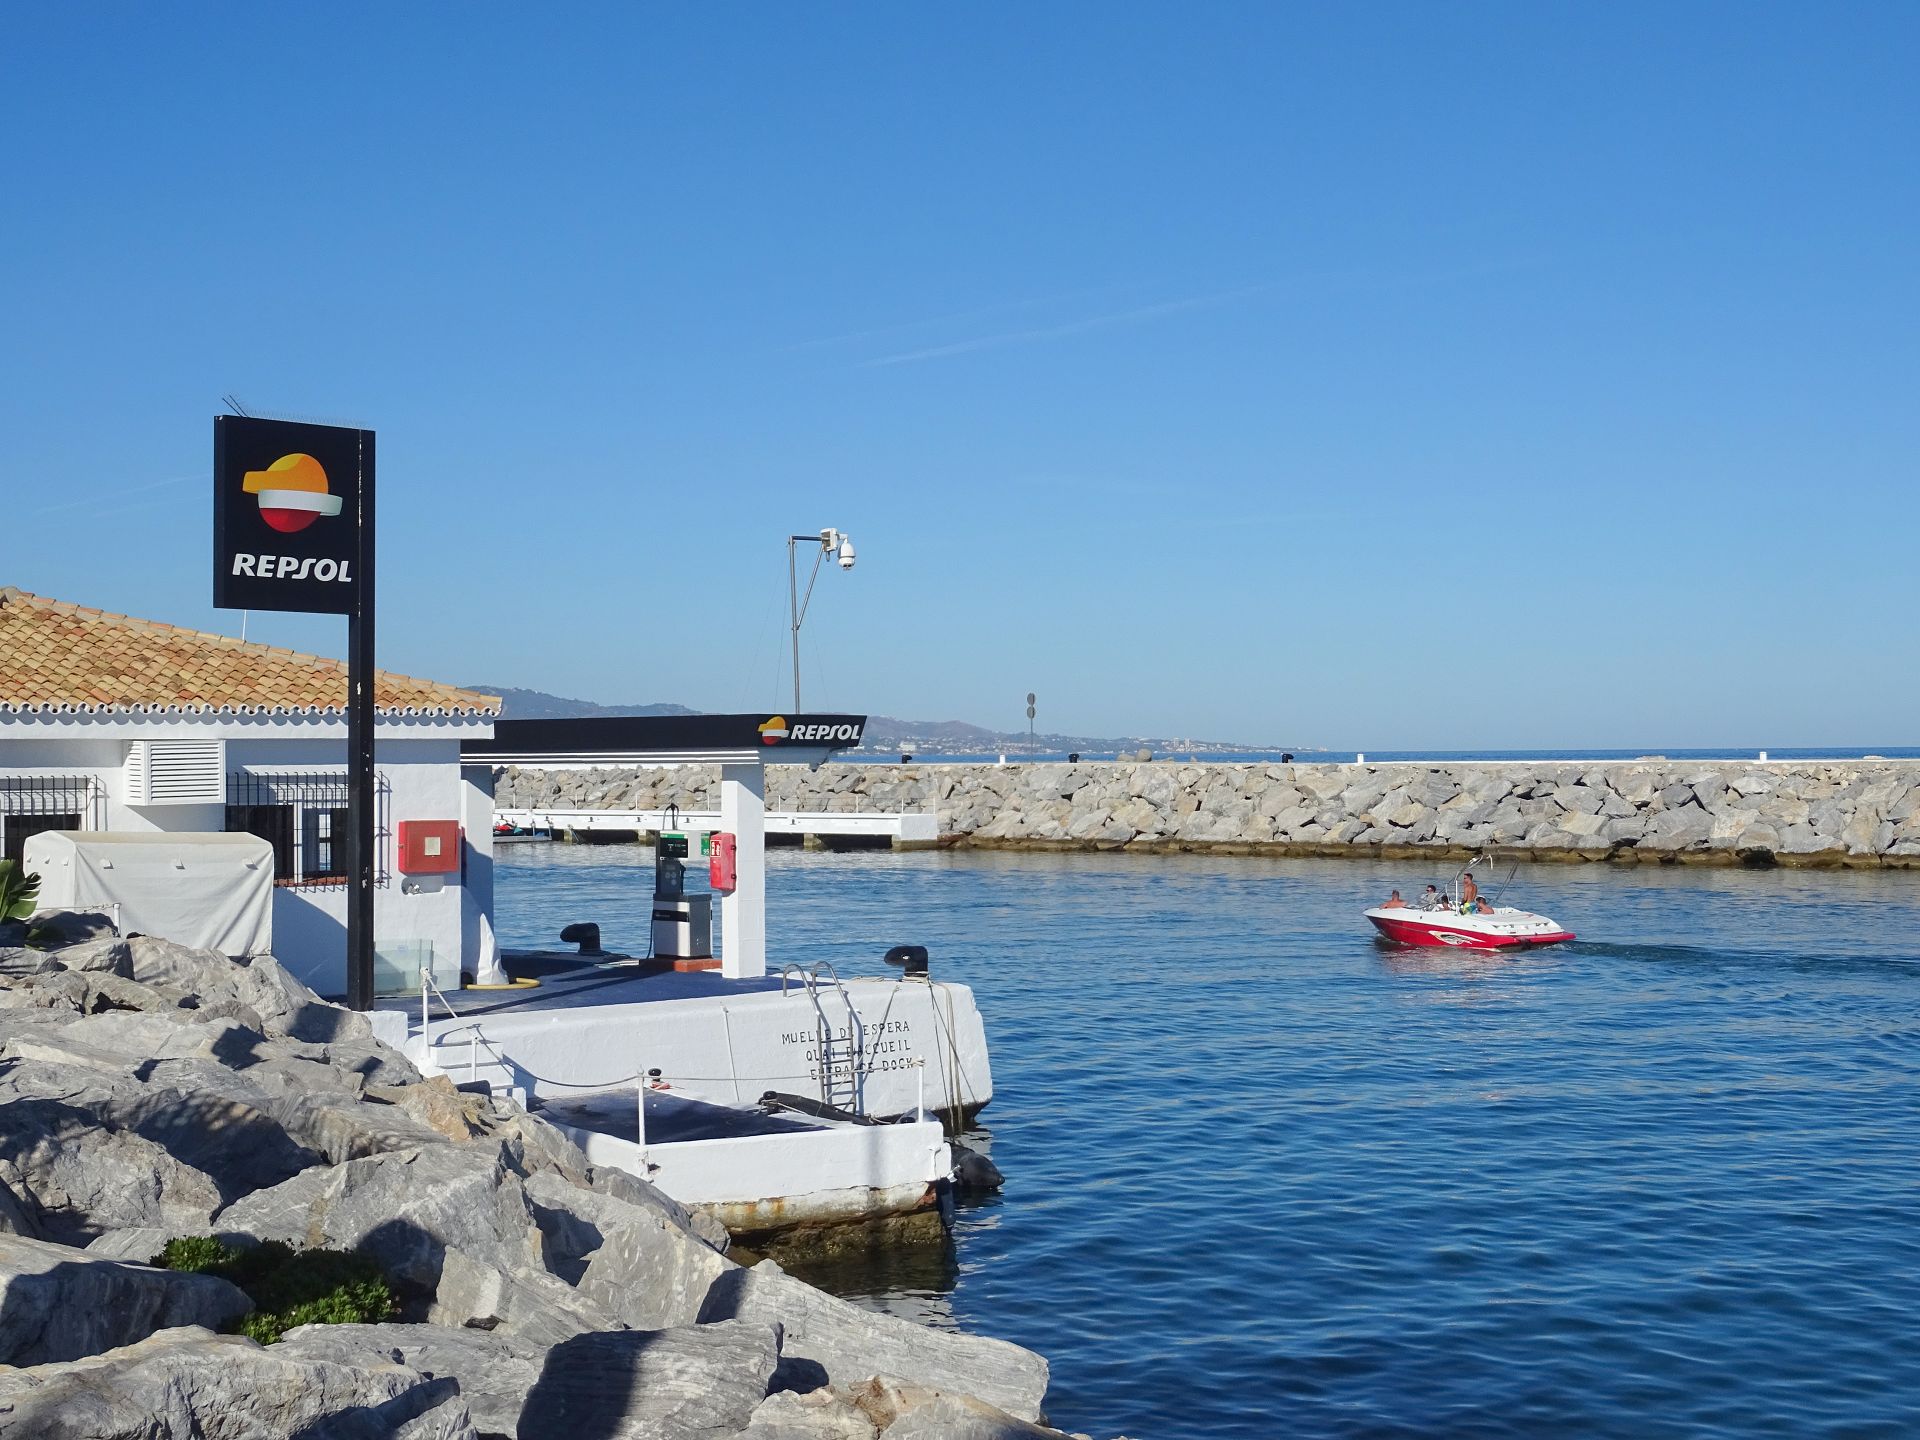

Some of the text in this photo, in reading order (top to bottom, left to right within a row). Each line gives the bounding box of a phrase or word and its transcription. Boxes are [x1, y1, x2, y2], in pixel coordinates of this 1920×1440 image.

[231, 553, 352, 583] REPSOL
[790, 724, 860, 740] REPSOL
[781, 1028, 832, 1045] MUELE
[862, 1020, 910, 1036] ESPERA
